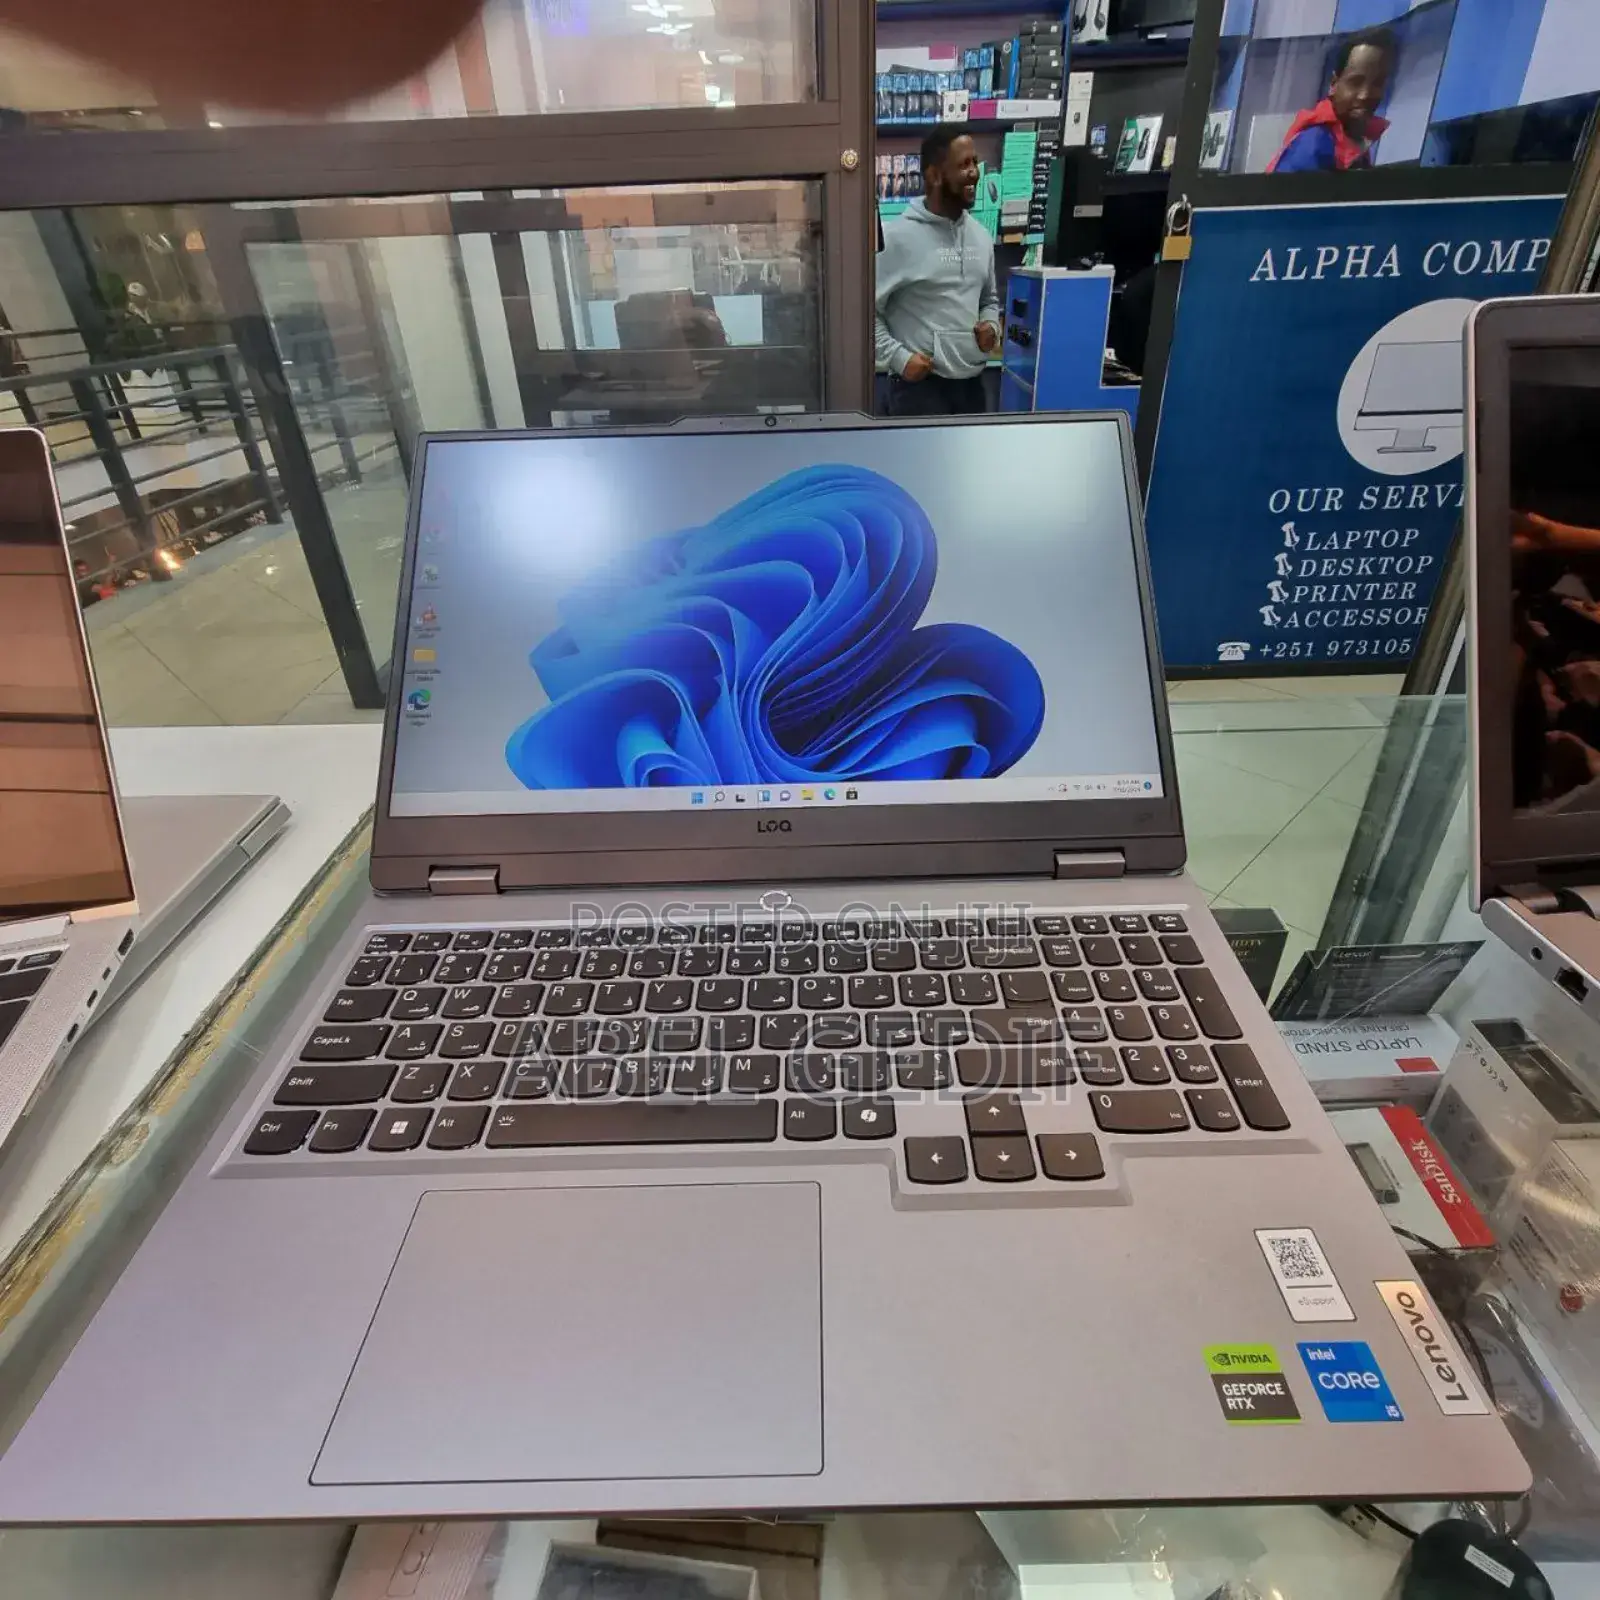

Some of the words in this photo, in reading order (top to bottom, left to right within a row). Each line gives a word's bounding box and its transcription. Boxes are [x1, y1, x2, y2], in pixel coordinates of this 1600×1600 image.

[1249, 244, 1401, 281] ALPHA
[1422, 238, 1552, 276] COMP
[1269, 487, 1344, 513] OUR
[1305, 528, 1420, 552] LAPTOP
[1297, 555, 1433, 578] DESKTOP
[1291, 581, 1417, 604] PRINTER
[1259, 641, 1314, 658] +251
[1326, 638, 1412, 656] 973105
[757, 819, 792, 833] LOQ
[439, 966, 450, 976] 2
[488, 966, 499, 976] 3
[1054, 973, 1066, 984] 7
[1100, 972, 1110, 982] 8
[1142, 971, 1153, 981] 9
[403, 990, 418, 1001] Q
[453, 988, 472, 999] W
[502, 987, 515, 998] E
[552, 986, 565, 997] R
[604, 984, 616, 995] T
[654, 983, 665, 993] Y
[704, 982, 716, 992] U
[803, 979, 817, 990] O
[854, 978, 865, 989] P
[336, 998, 354, 1006] Tab
[313, 1036, 352, 1046] CapsLk
[397, 1027, 411, 1038] A
[451, 1025, 465, 1037] S
[503, 1024, 516, 1035] D
[555, 1023, 568, 1034] F
[609, 1021, 622, 1032] G
[662, 1019, 674, 1030] H
[714, 1018, 724, 1029] J
[766, 1018, 778, 1029] K
[1026, 1017, 1053, 1026] Enter
[1070, 1010, 1080, 1021] 4
[1114, 1010, 1125, 1020] 5
[1159, 1009, 1170, 1020] 6
[1279, 1027, 1313, 1037] STOR
[1294, 1039, 1352, 1055] STAND
[1356, 1036, 1424, 1051] LAPTOP
[289, 1077, 316, 1086] Shift
[404, 1067, 421, 1079] Z
[460, 1066, 475, 1078] X
[516, 1064, 530, 1076] C
[573, 1062, 585, 1074] V
[626, 1061, 639, 1072] B
[681, 1060, 695, 1071] N
[736, 1059, 751, 1070] M
[1040, 1058, 1064, 1067] Shift
[1129, 1050, 1140, 1061] 2
[1175, 1049, 1188, 1060] 3
[260, 1123, 281, 1133] Ctrl
[323, 1122, 339, 1131] Fn
[438, 1118, 455, 1127] Alt
[790, 1109, 805, 1119] Alt
[1100, 1095, 1112, 1108] 0
[1234, 1078, 1264, 1087] Enter
[1409, 1137, 1462, 1205] SanDisk
[1395, 1291, 1470, 1402] Lenovo
[1222, 1382, 1286, 1396] GEFORCE
[1226, 1397, 1256, 1410] RTX
